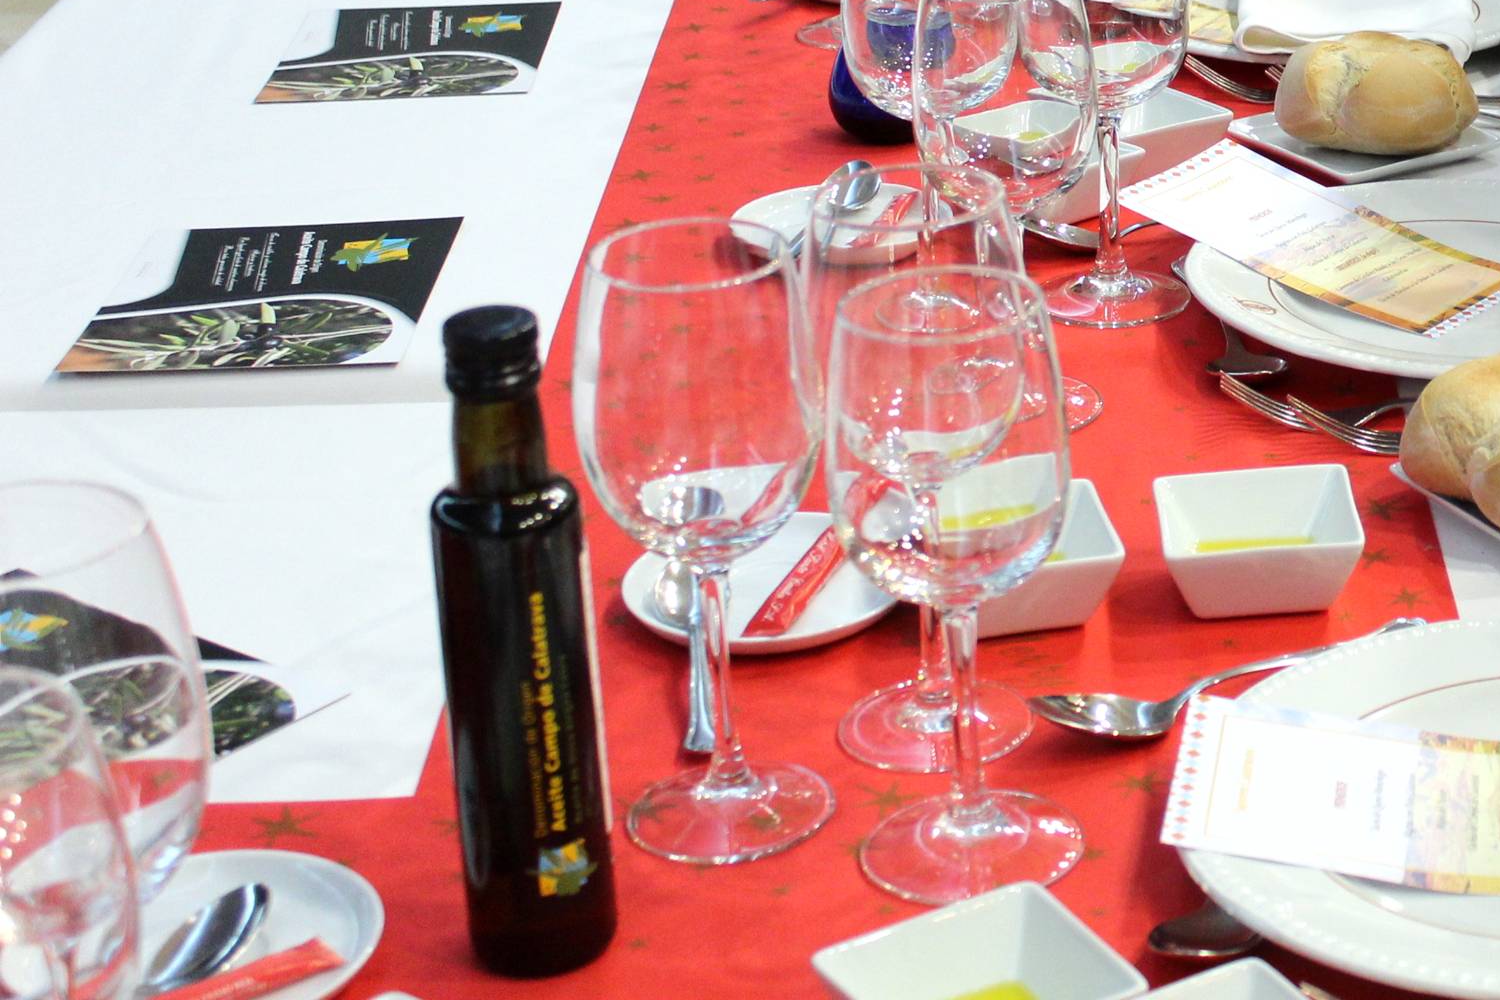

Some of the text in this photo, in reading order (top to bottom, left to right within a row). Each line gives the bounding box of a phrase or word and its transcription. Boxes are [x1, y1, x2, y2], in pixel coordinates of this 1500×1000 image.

[520, 680, 538, 726] Origen
[529, 591, 567, 832] Aceite Campo de Calatrava
[525, 727, 538, 745] de
